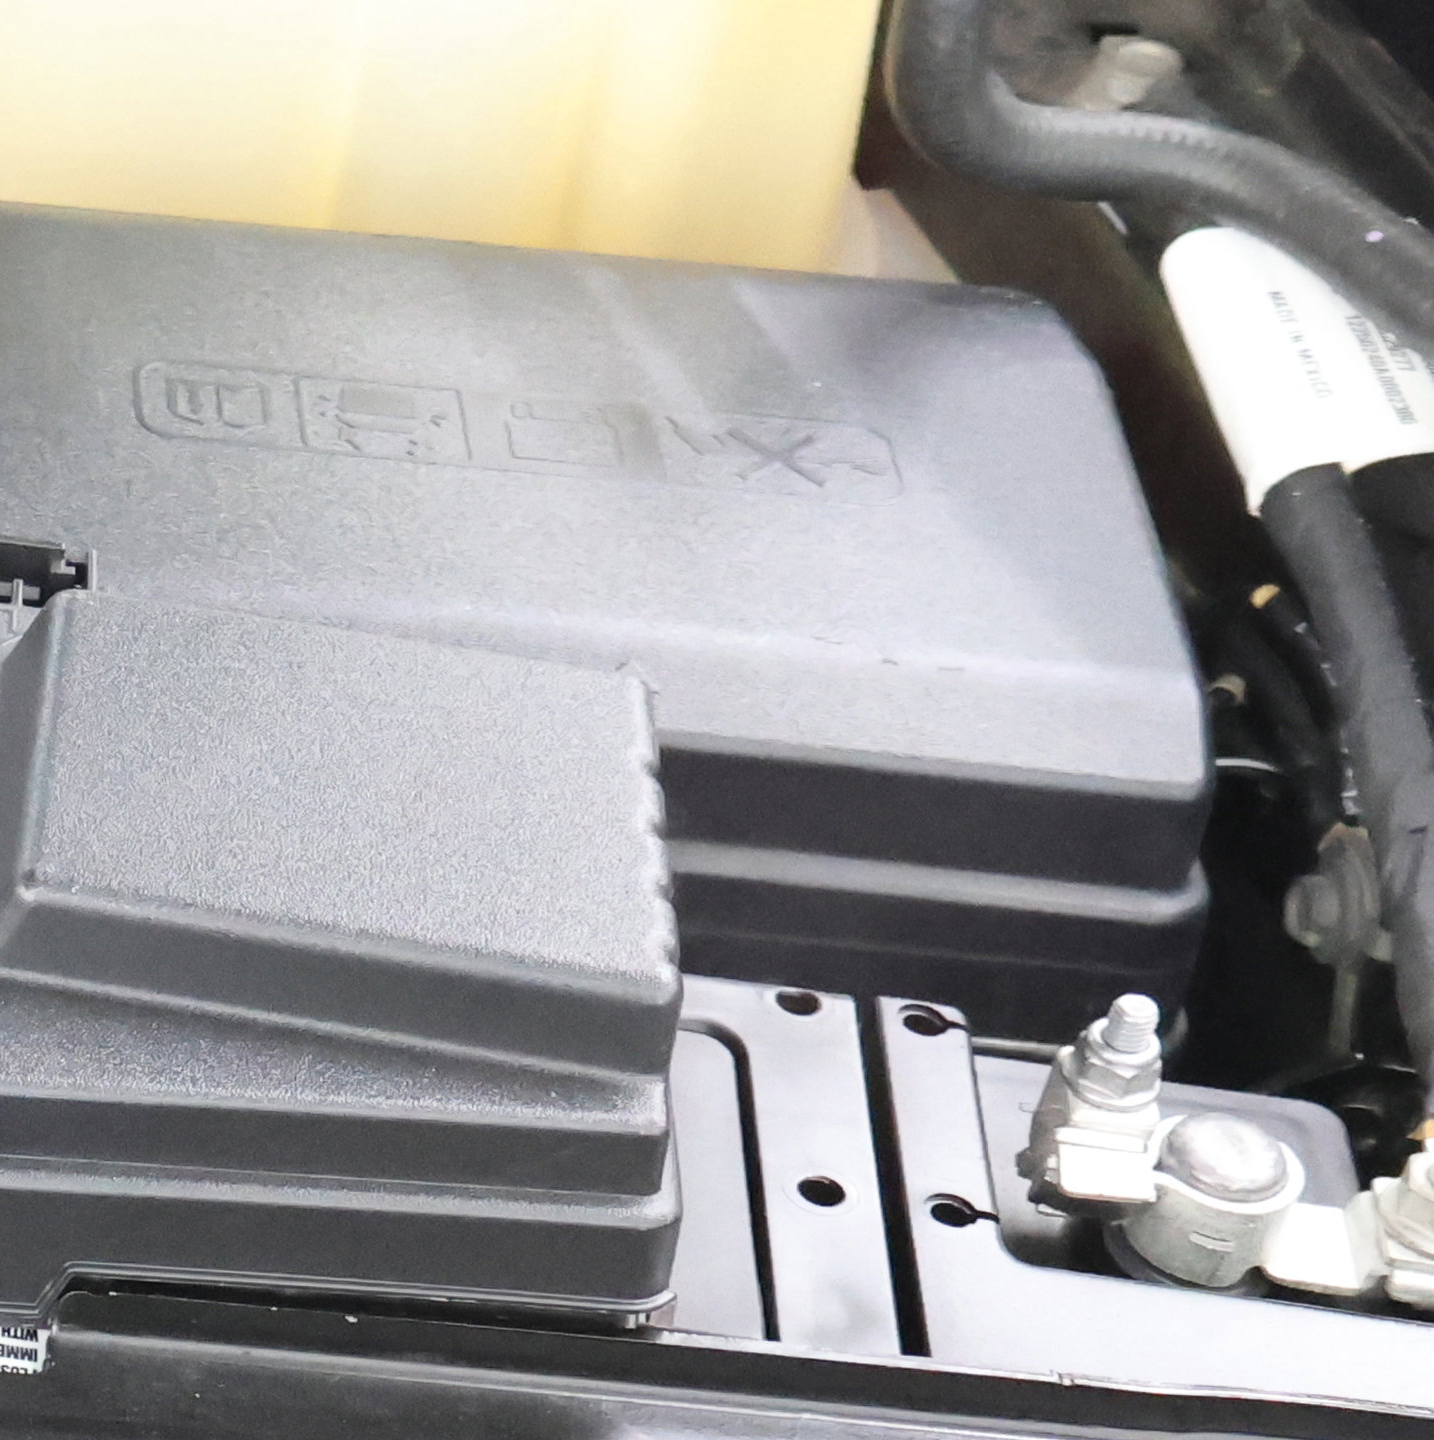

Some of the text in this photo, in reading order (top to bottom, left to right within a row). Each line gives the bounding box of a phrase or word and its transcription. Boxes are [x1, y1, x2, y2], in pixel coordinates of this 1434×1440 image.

[1266, 290, 1299, 324] MADE
[1296, 347, 1333, 399] MEXICO
[2, 1327, 39, 1343] WITH
